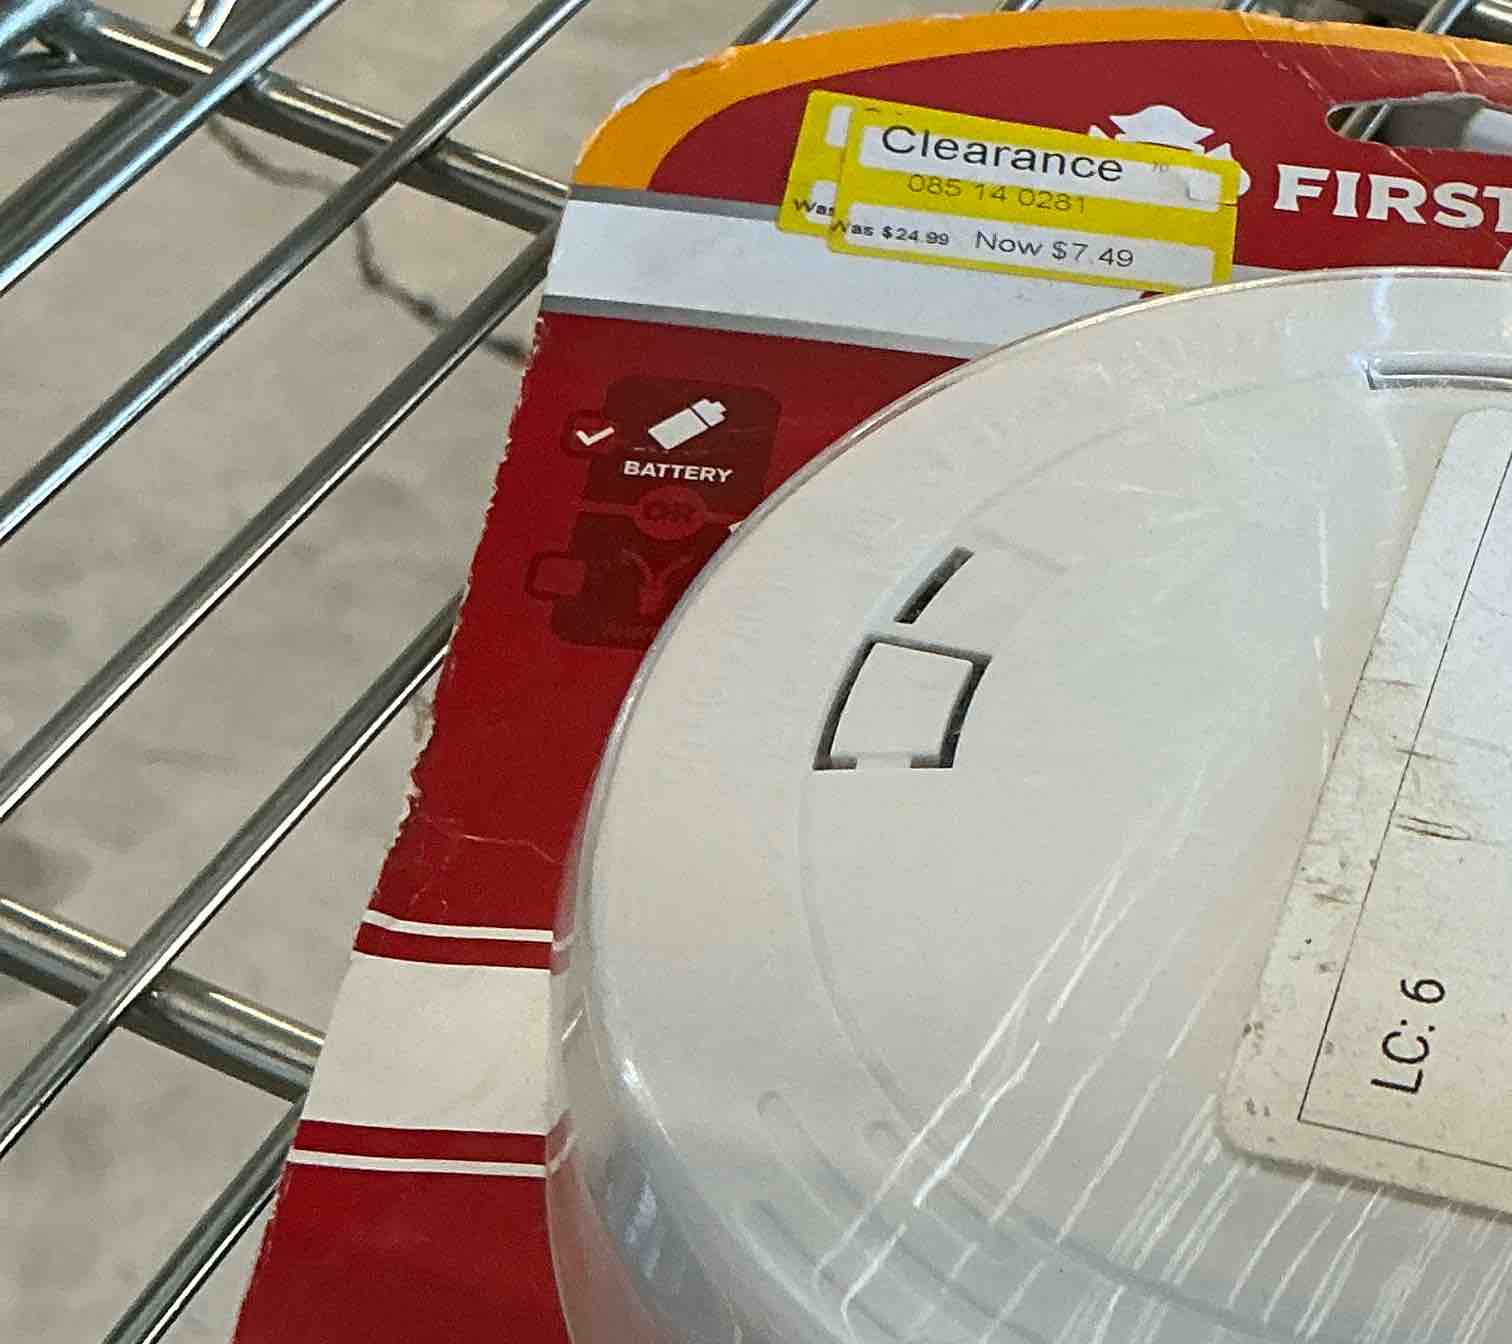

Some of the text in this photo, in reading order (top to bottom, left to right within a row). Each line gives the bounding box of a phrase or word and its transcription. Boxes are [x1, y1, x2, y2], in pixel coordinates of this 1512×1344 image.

[882, 124, 1123, 183] Clearance
[907, 173, 962, 197] 085
[975, 178, 1008, 201] 14
[882, 225, 949, 246] $24.99
[976, 229, 1041, 258] Now
[623, 460, 734, 483] BATTERY
[1370, 977, 1446, 1096] LC: 6
